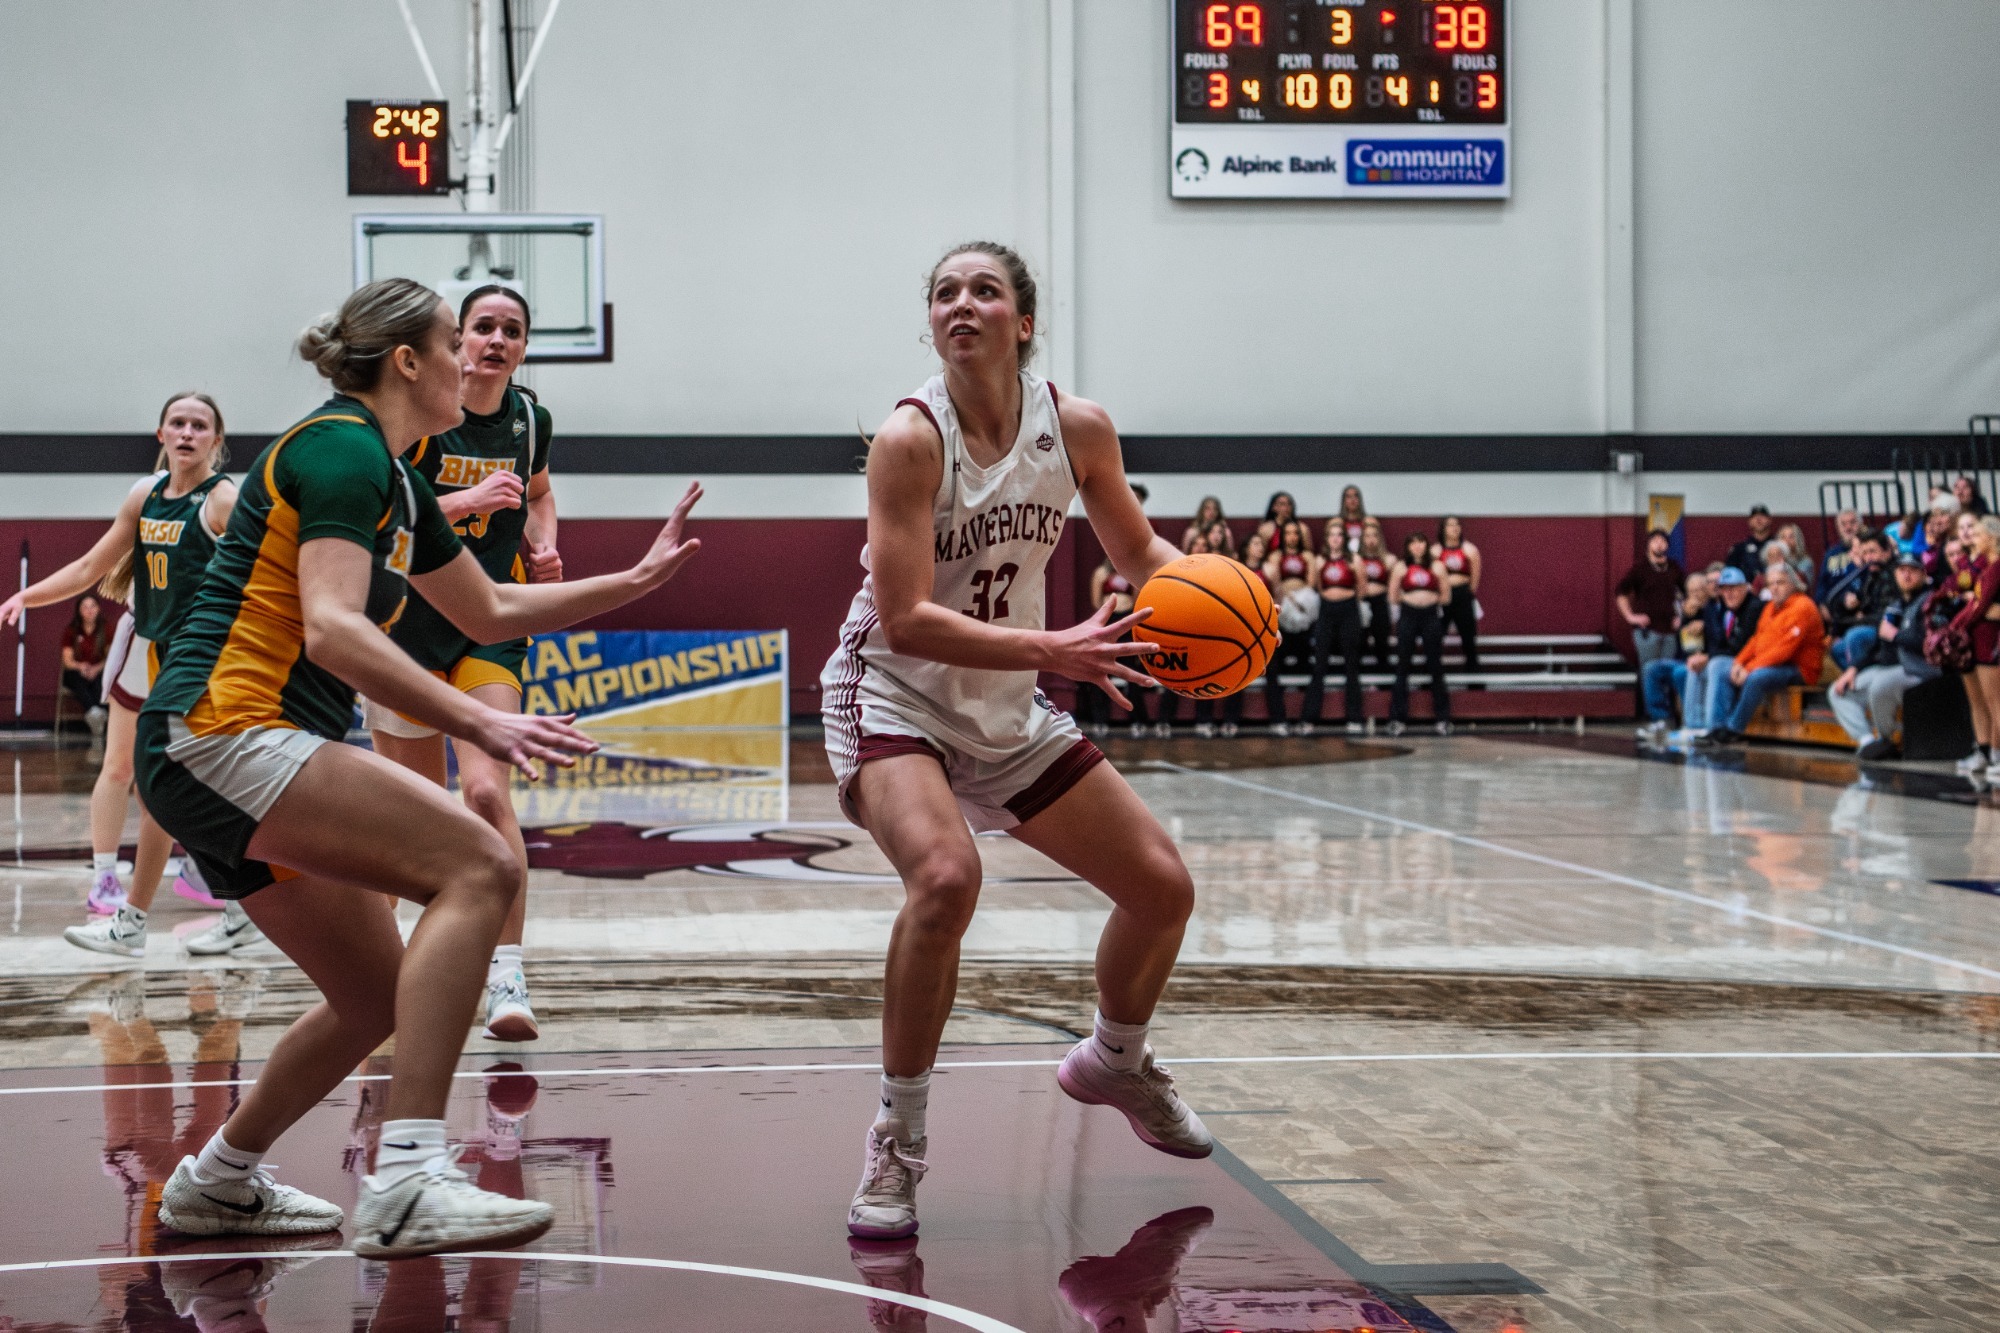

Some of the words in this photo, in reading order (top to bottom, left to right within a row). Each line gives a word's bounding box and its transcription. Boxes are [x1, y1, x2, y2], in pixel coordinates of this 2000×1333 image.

[1206, 5, 1261, 47] 69
[1331, 10, 1351, 44] 3
[1435, 6, 1487, 48] 38
[1184, 53, 1229, 69] FOULS
[1278, 53, 1312, 69] PLYR
[1323, 54, 1358, 70] FOUL
[1372, 54, 1399, 70] PTS
[1452, 54, 1497, 70] FOULS
[1208, 73, 1228, 107] 3
[1241, 79, 1260, 102] 4
[1285, 74, 1318, 108] 10
[1329, 74, 1351, 108] 0
[1385, 76, 1408, 106] 4
[1430, 80, 1439, 102] 1
[1478, 74, 1497, 108] 3
[373, 107, 439, 137] 2:42
[398, 141, 427, 185] 4
[1222, 154, 1283, 176] Alpine
[1289, 155, 1337, 173] Bank
[1353, 143, 1497, 175] Community
[1407, 168, 1485, 181] HOSPITAL
[934, 503, 1063, 563] MAVERICKS
[146, 551, 168, 590] 10
[961, 562, 1019, 623] 32
[521, 631, 602, 683] AC
[525, 632, 782, 715] AMPIONSHIP
[1143, 652, 1189, 671] NCA
